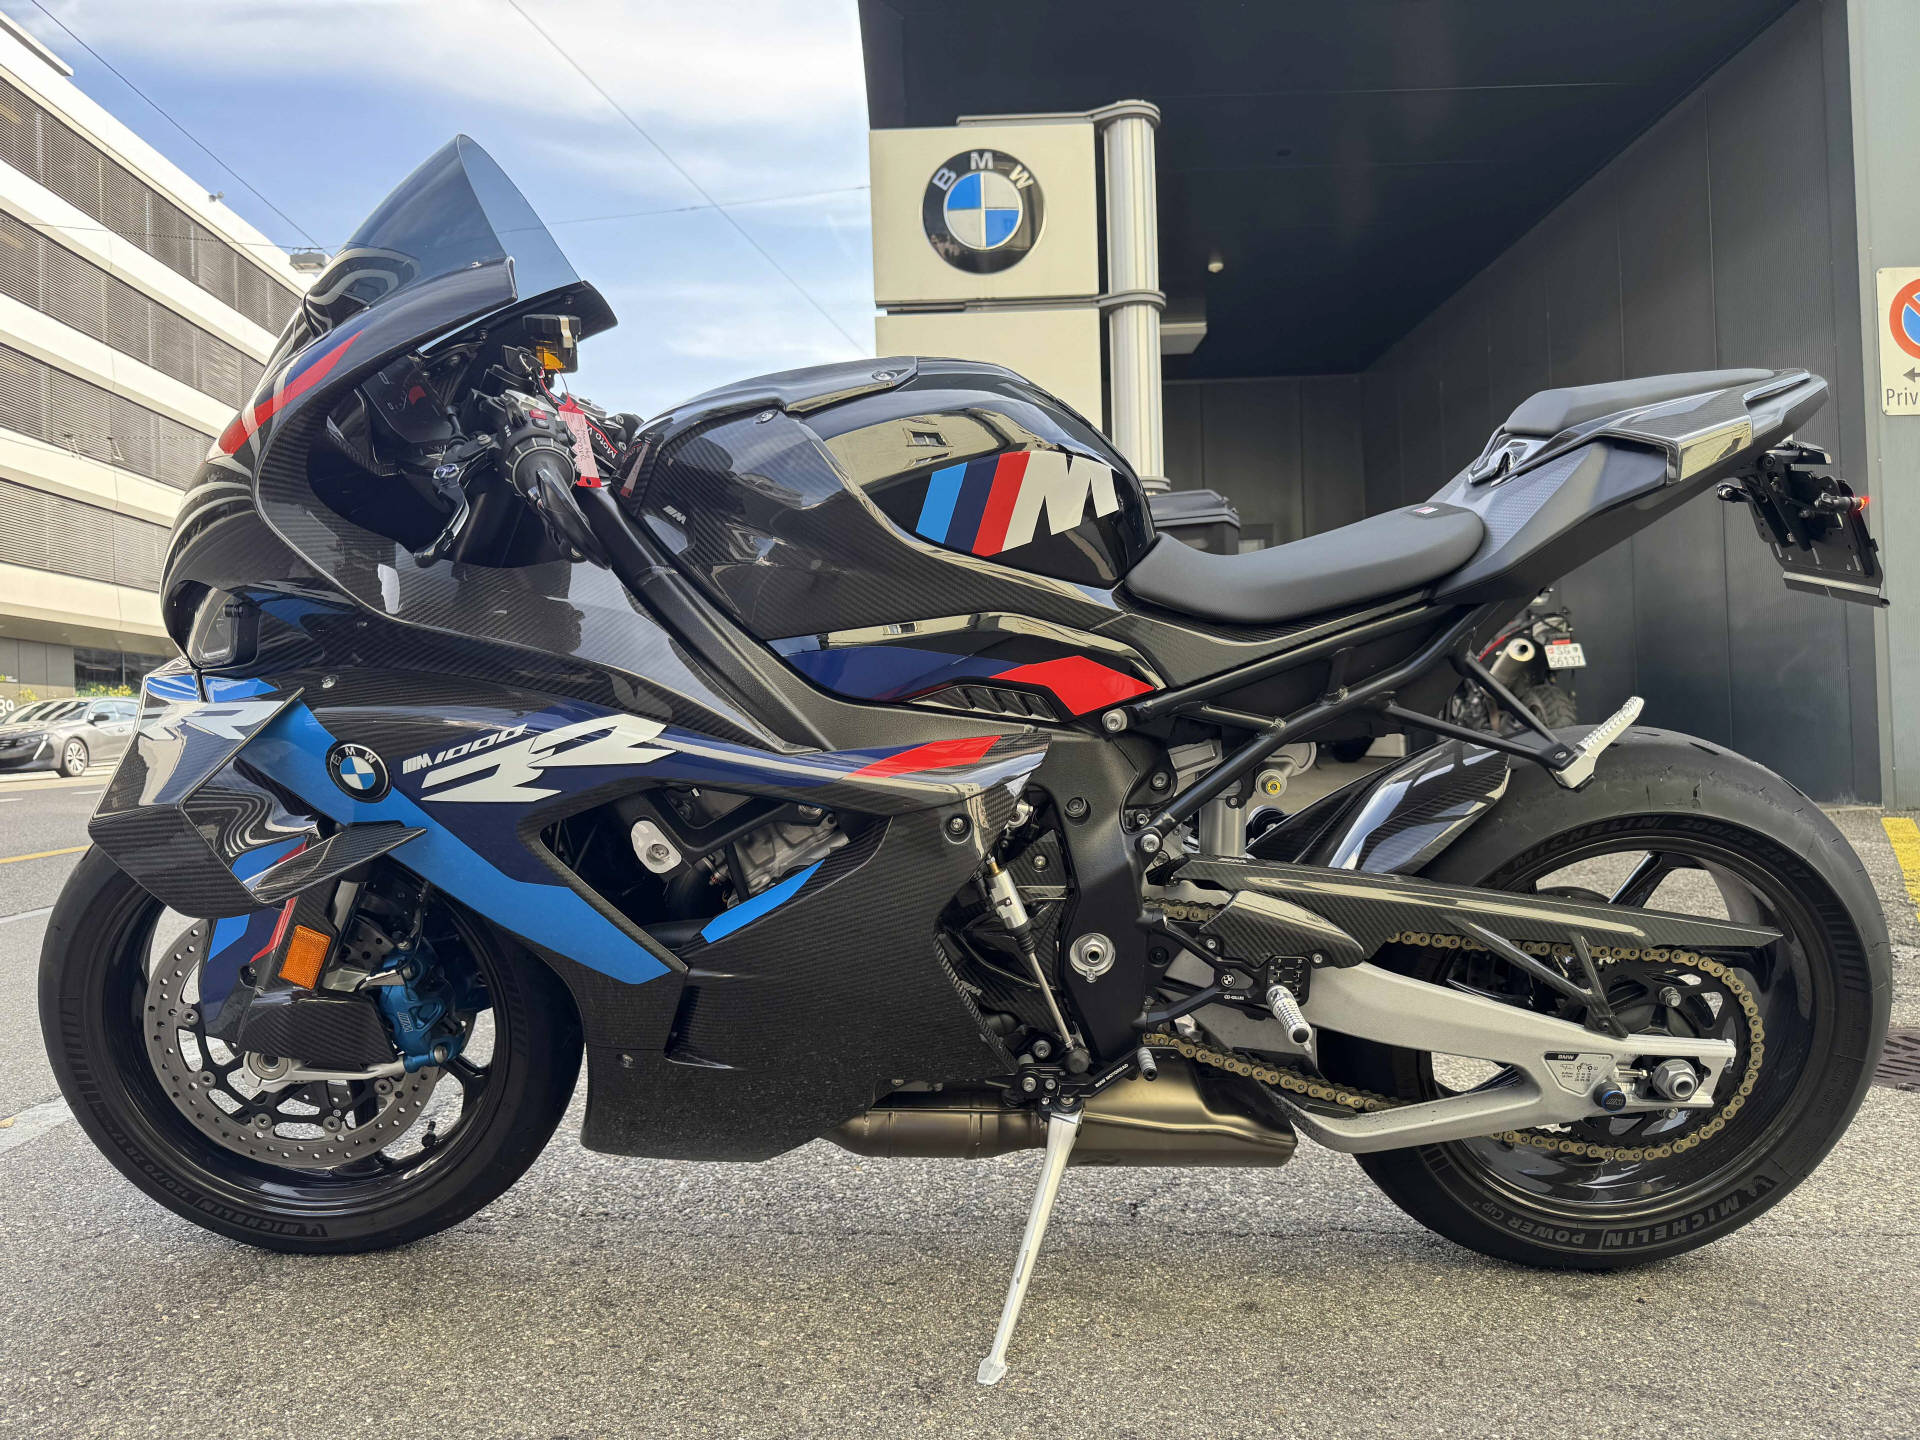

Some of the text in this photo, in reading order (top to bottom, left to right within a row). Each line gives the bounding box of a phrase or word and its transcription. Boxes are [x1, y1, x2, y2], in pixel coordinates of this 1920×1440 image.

[932, 151, 1033, 191] BMW
[332, 746, 376, 766] BMW
[200, 1202, 299, 1234] MICHELIN
[1507, 1217, 1586, 1244] POWER
[1605, 1195, 1740, 1246] MICHELIN
